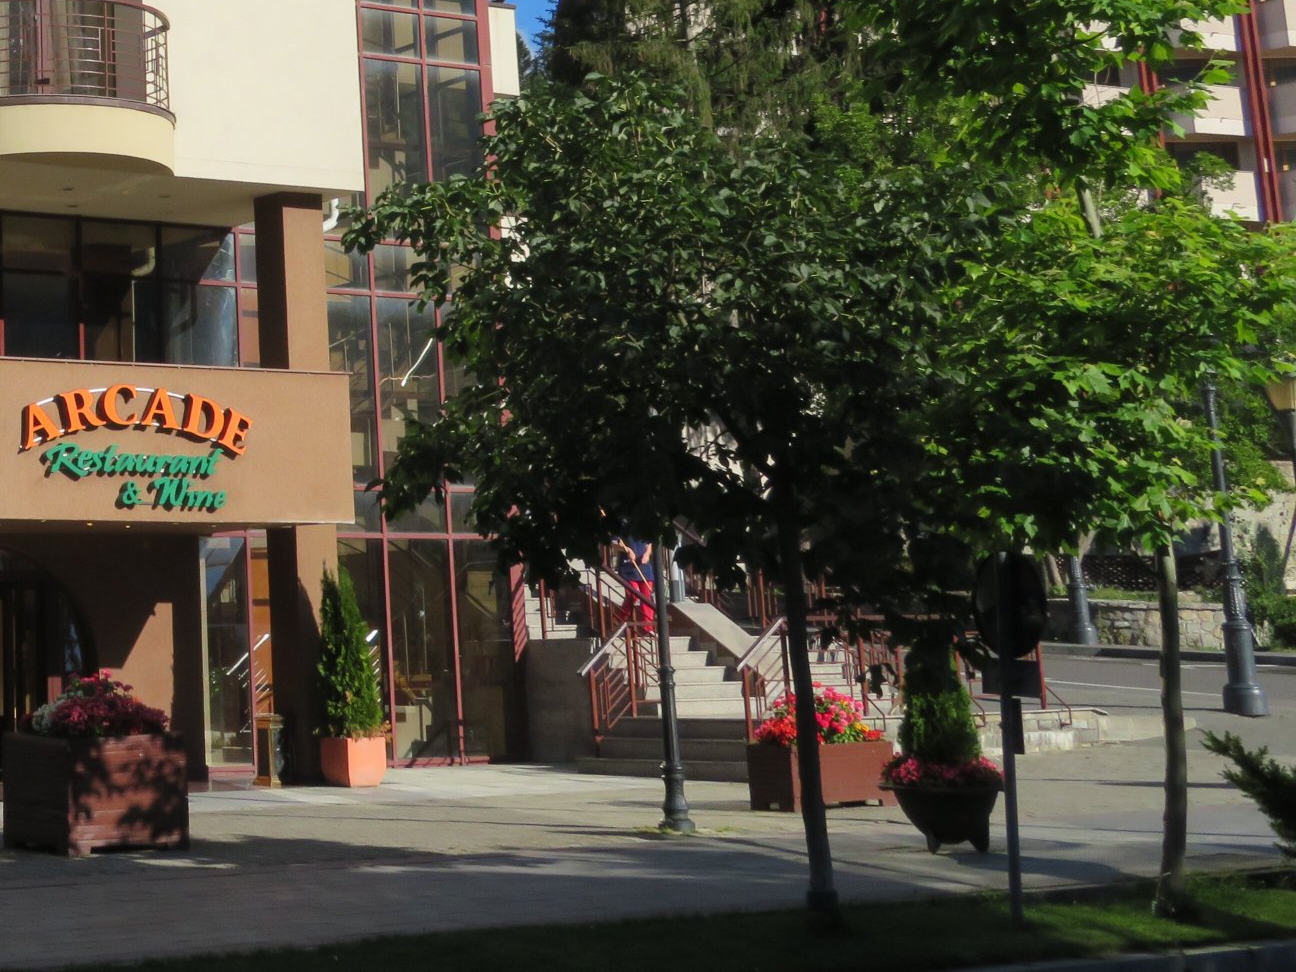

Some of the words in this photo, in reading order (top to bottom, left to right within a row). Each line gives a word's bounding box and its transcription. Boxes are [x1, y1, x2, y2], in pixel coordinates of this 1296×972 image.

[22, 383, 253, 455] ARCADE
[43, 441, 225, 478] Restaurant
[121, 480, 143, 506] &
[152, 476, 228, 508] Wine
